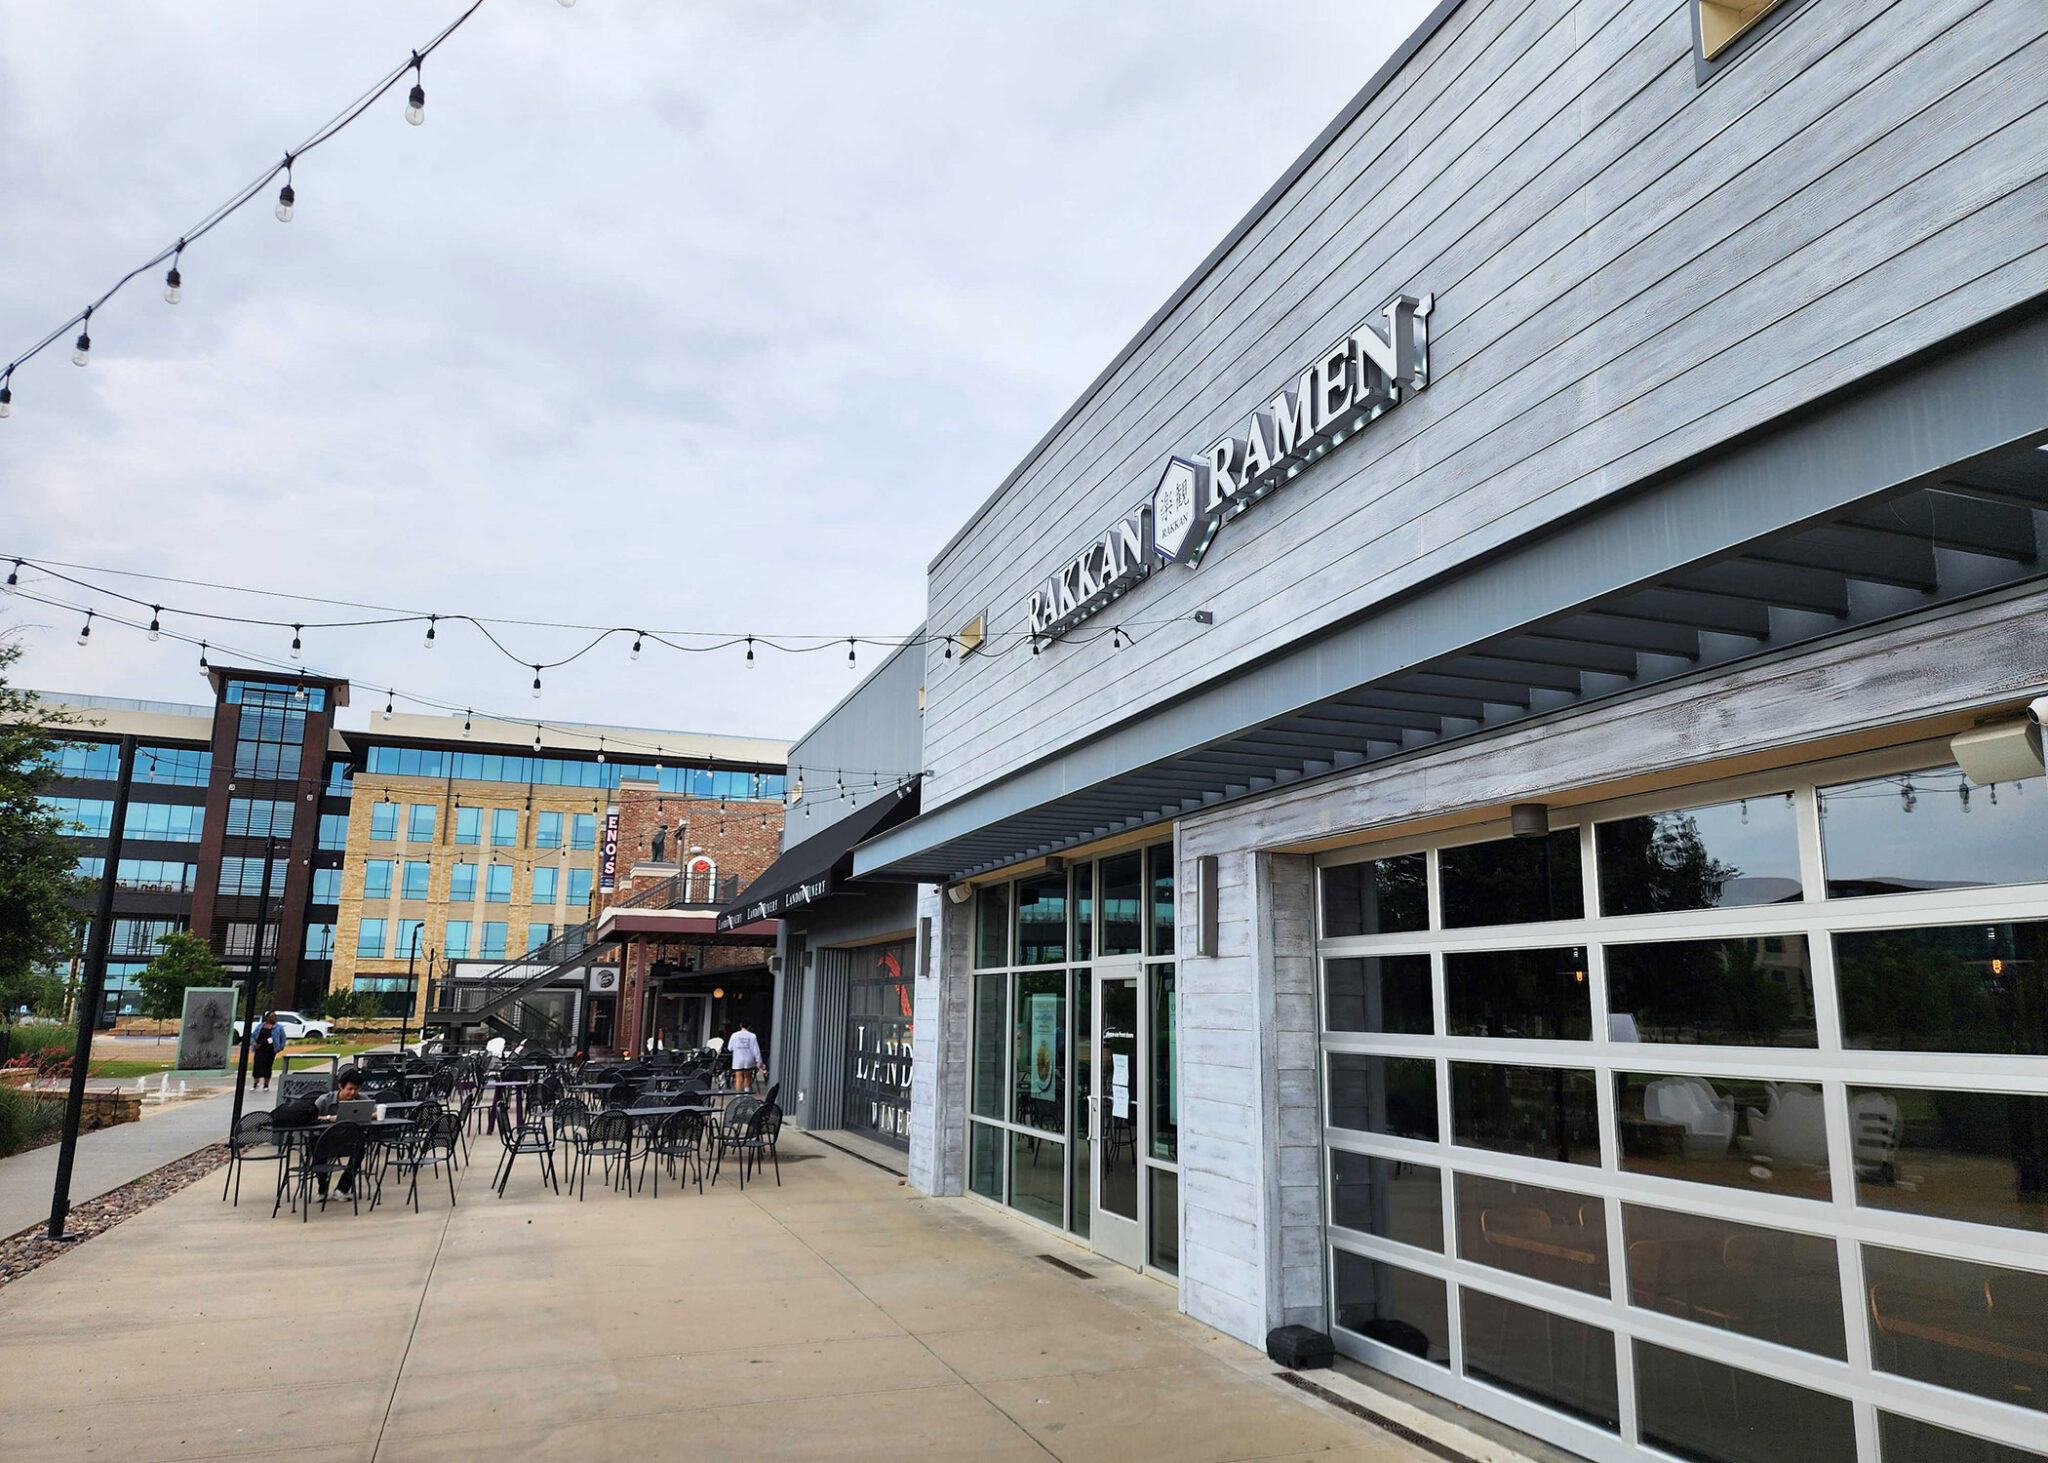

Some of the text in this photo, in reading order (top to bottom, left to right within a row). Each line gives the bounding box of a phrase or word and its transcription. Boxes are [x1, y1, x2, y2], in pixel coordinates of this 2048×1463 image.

[1204, 293, 1419, 515] RAMEN
[1026, 503, 1151, 644] RAKKAN
[1161, 511, 1189, 540] RAKKAN
[603, 815, 619, 875] ENO'S
